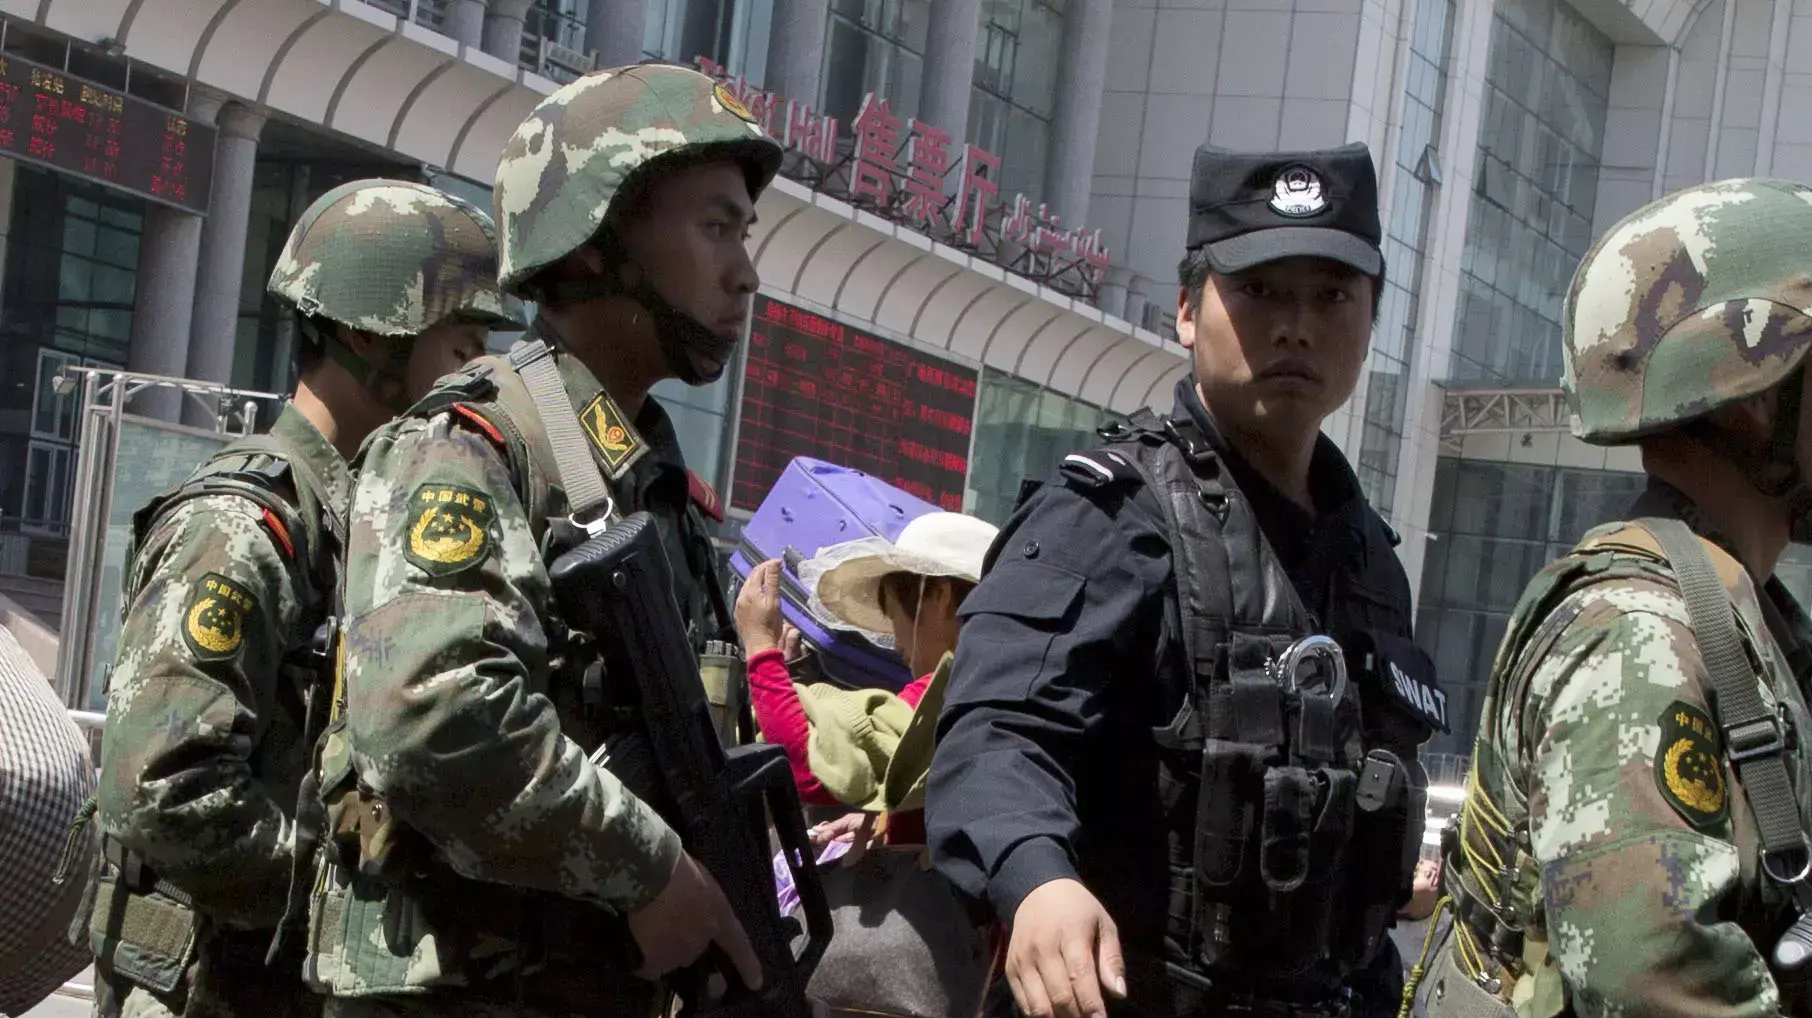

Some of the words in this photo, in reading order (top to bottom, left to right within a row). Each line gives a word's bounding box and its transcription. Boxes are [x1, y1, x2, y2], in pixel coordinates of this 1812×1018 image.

[783, 99, 838, 165] Hall
[850, 92, 1001, 246] 售票厅
[421, 490, 486, 513] 中国武警
[1390, 661, 1446, 726] SWAT
[1675, 711, 1713, 743] 中国武
